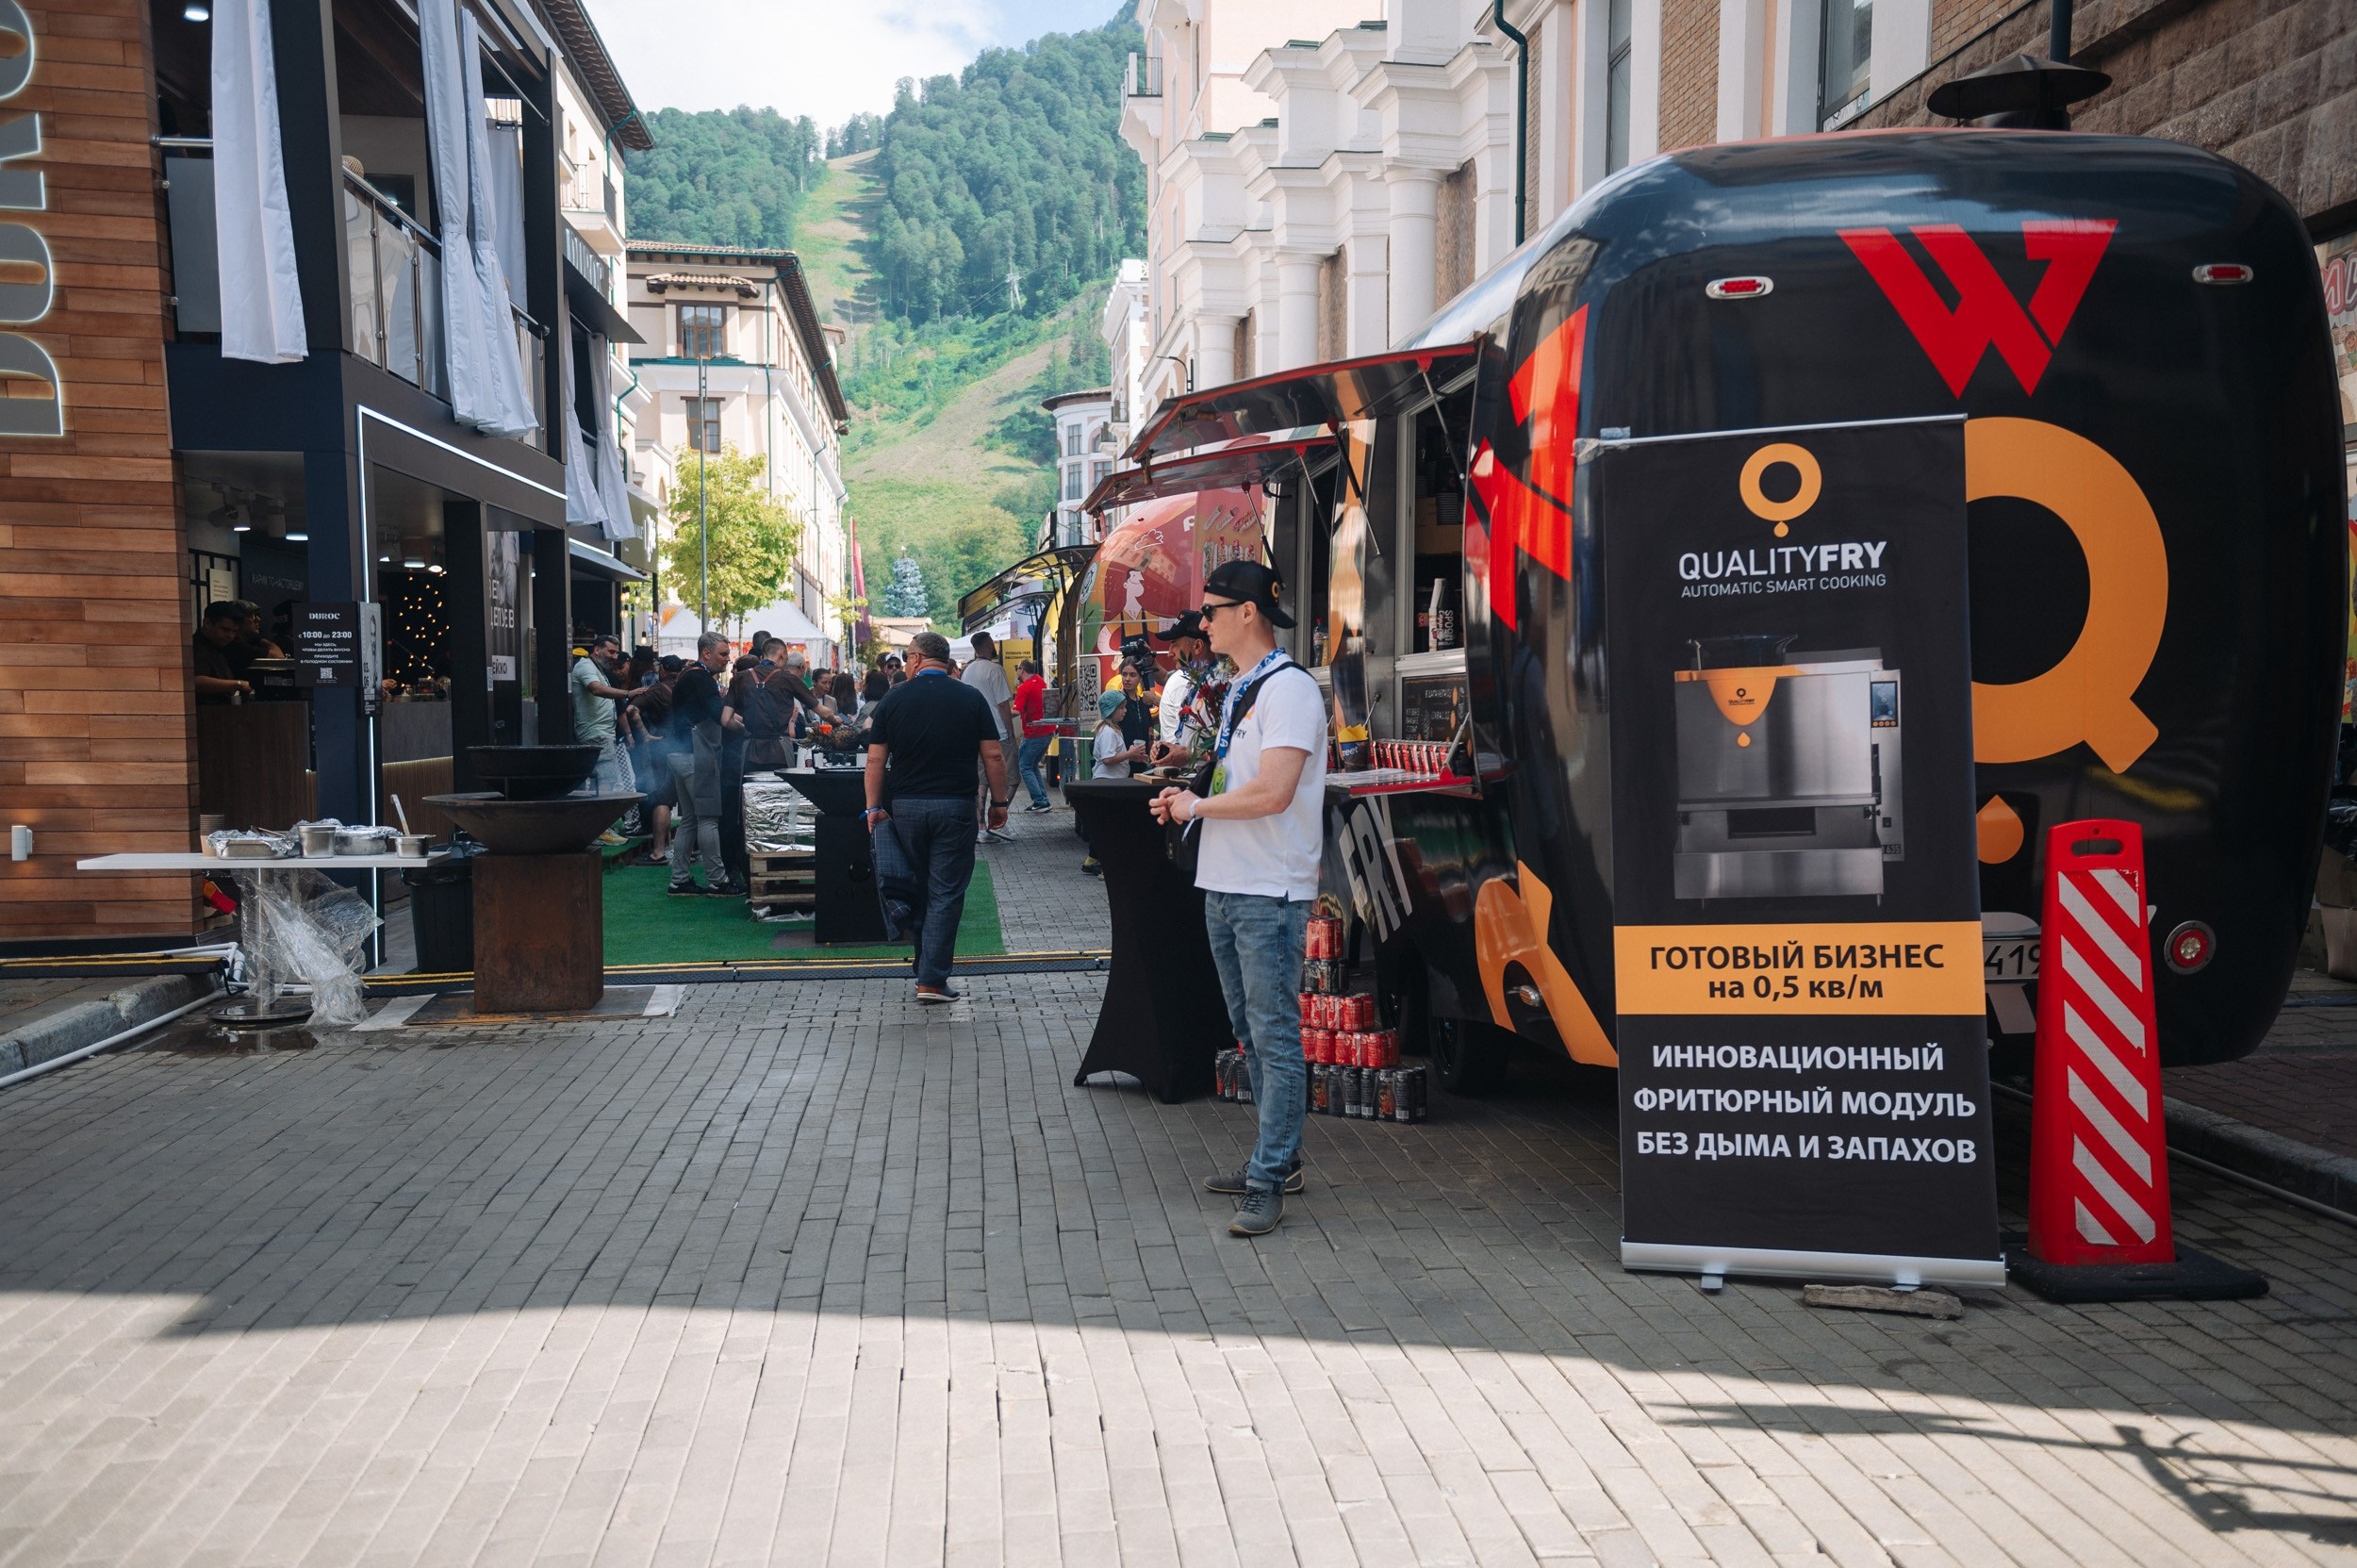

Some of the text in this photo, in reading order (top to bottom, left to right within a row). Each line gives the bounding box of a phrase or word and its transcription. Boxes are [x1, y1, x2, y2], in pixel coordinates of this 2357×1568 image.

[1678, 540, 1887, 581] QUALITYFRY
[1681, 573, 1887, 599] AUTOMATIC SMART COOKING
[308, 612, 340, 620] DUROC
[1650, 941, 1945, 970] ГОТОВЫЙ БИЗНЕС
[1708, 974, 1885, 1002] на 0,5 кв/м
[1652, 1041, 1944, 1074] ИННОВАЦИОННЫЙ
[1633, 1084, 1976, 1122] ФРИТЮРНЫЙ МОДУЛЬ
[1637, 1131, 1977, 1164] БЕЗ ДЫМА И ЗАПАХОВ
